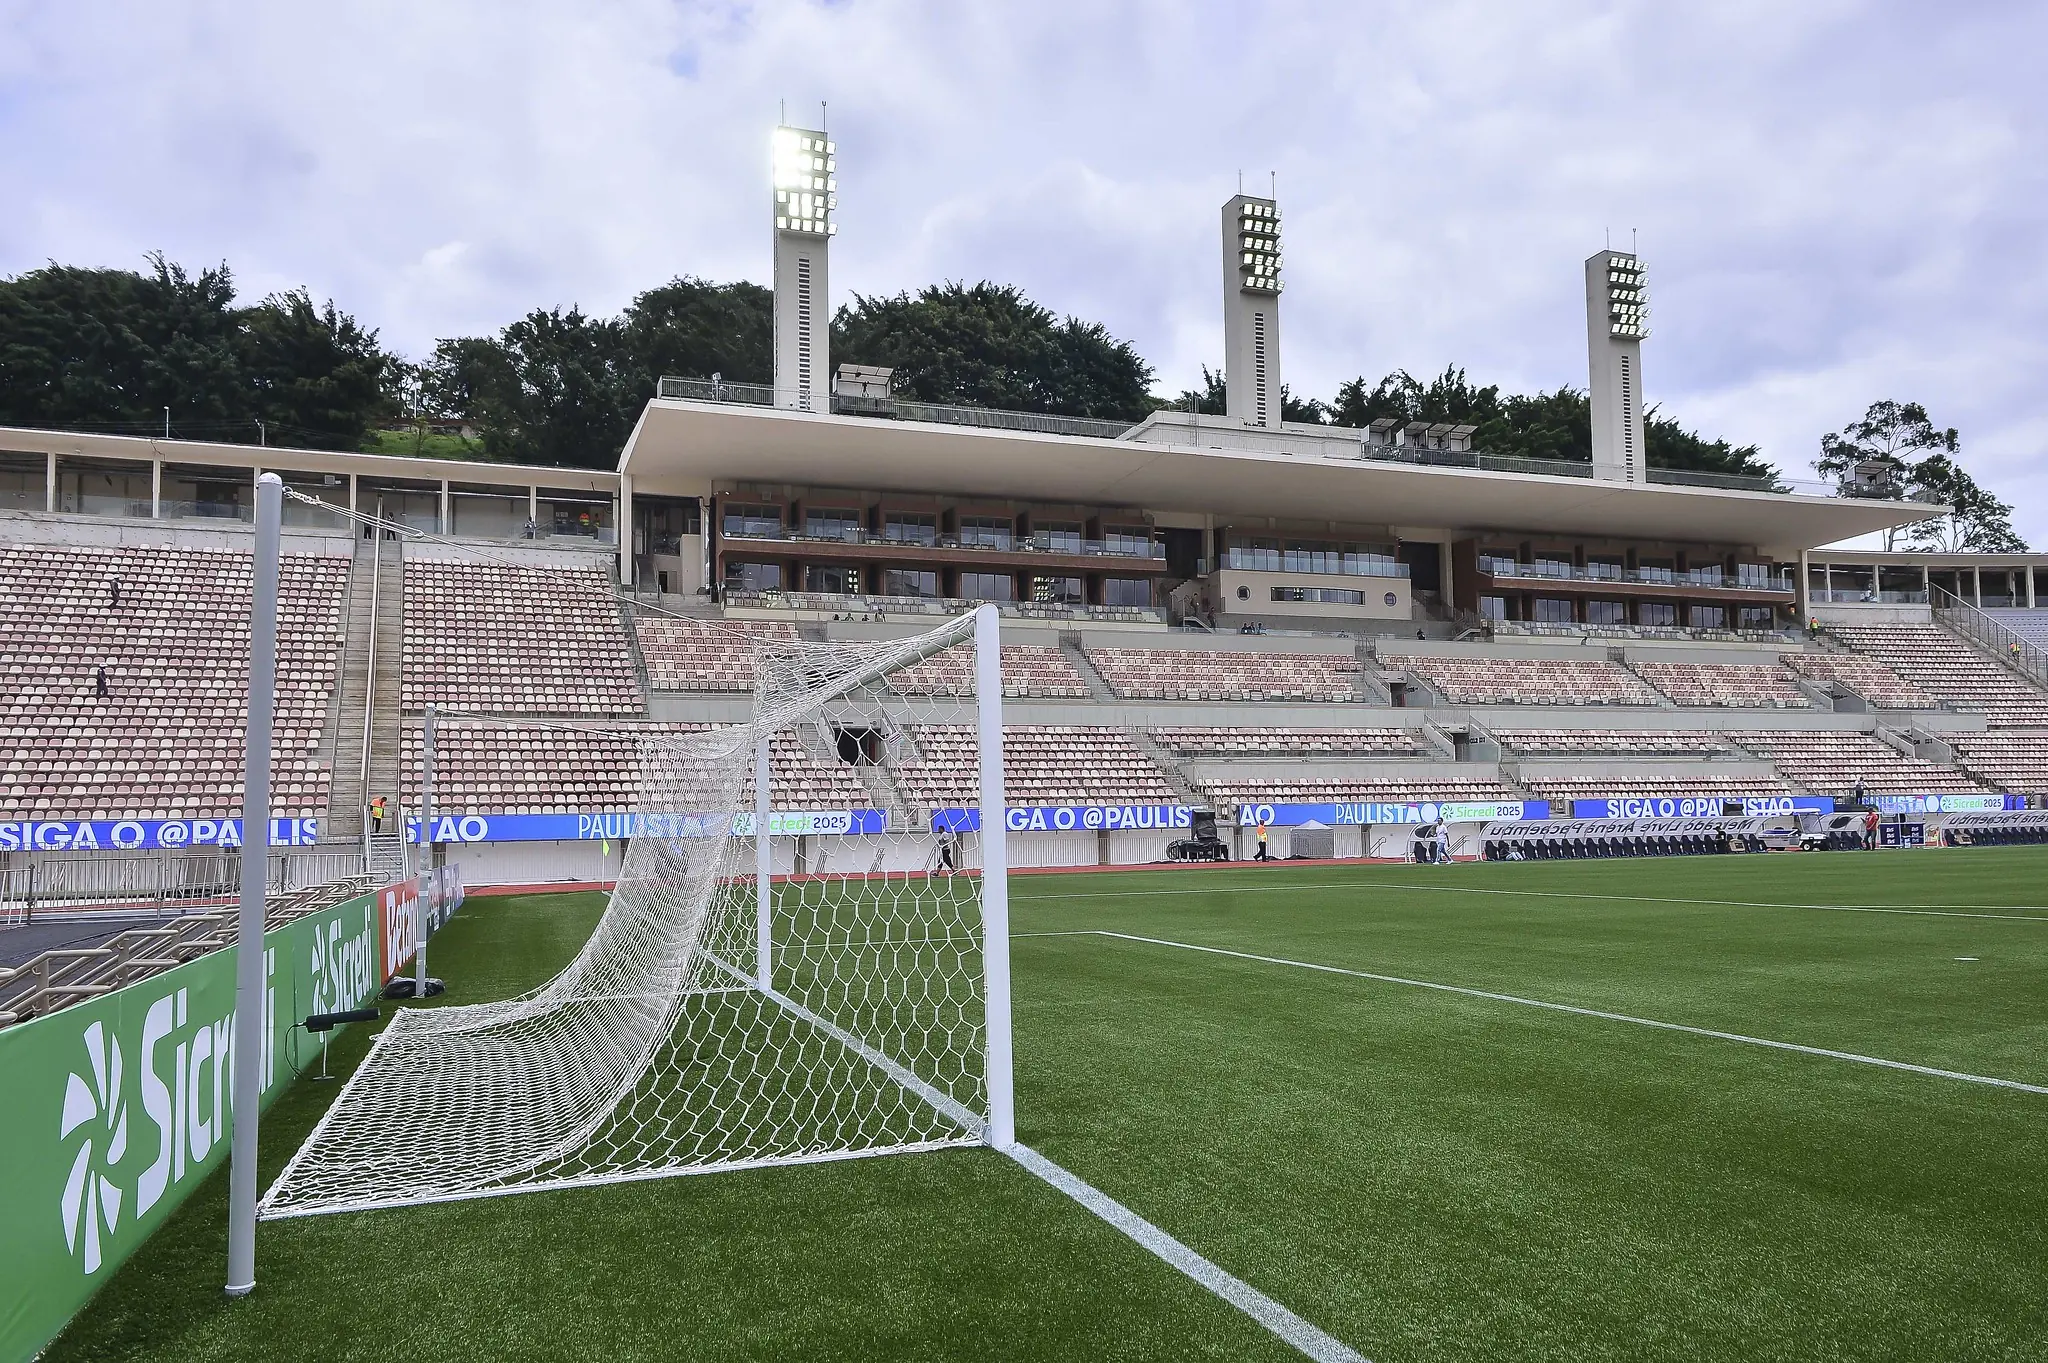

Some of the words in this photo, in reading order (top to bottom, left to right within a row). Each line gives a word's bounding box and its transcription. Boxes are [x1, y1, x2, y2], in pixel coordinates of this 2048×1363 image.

[1457, 806, 1495, 818] Sicredi
[1497, 806, 1520, 817] 2025
[1607, 799, 1655, 819] SIGA
[1659, 799, 1675, 818] O
[1953, 798, 1982, 808] Sicredi
[1983, 798, 2002, 808] 2025
[813, 816, 847, 829] 2025
[1053, 808, 1076, 830] O
[0, 822, 100, 851] SIGA
[110, 821, 144, 849] O
[157, 819, 317, 849] @PALIS
[386, 890, 419, 977] Betan
[328, 904, 373, 1016] Sicredi
[136, 947, 275, 1220] Sicri
